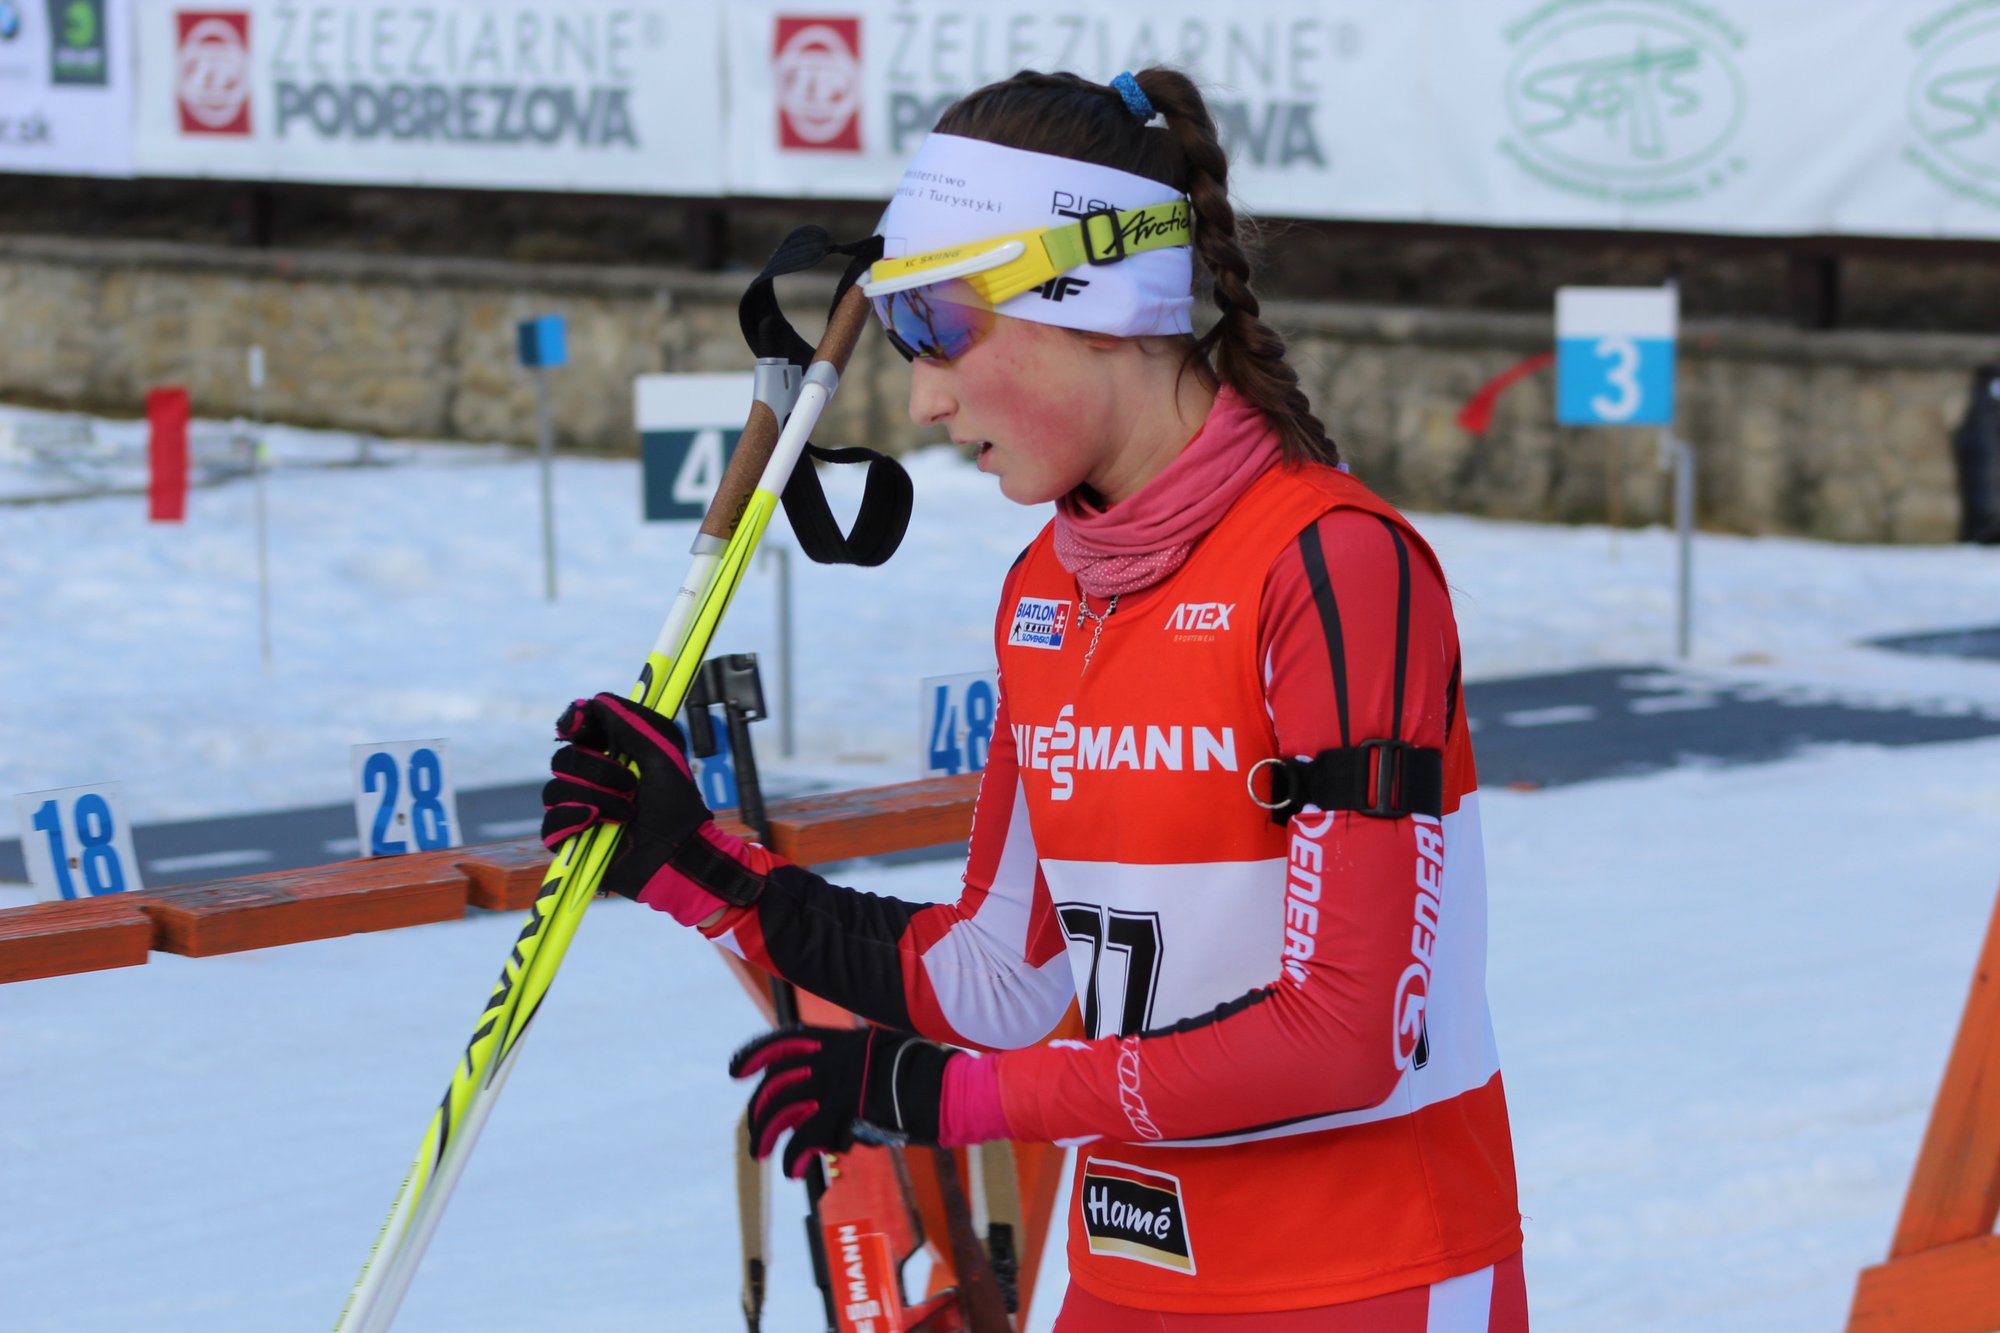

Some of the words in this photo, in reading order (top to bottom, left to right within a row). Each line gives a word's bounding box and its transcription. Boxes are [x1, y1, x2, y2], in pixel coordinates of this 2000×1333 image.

[929, 189, 1002, 213] Turystyki
[1592, 336, 1641, 421] 3
[672, 430, 726, 506] 4
[1016, 602, 1056, 621] BIATLON
[1022, 633, 1050, 644] SLOVENSKO
[1164, 602, 1236, 631] ATEX
[930, 679, 995, 776] 48
[363, 748, 450, 856] 28
[32, 793, 126, 901] 18
[1054, 901, 1164, 1041] 77
[1088, 1185, 1171, 1240] Hamé
